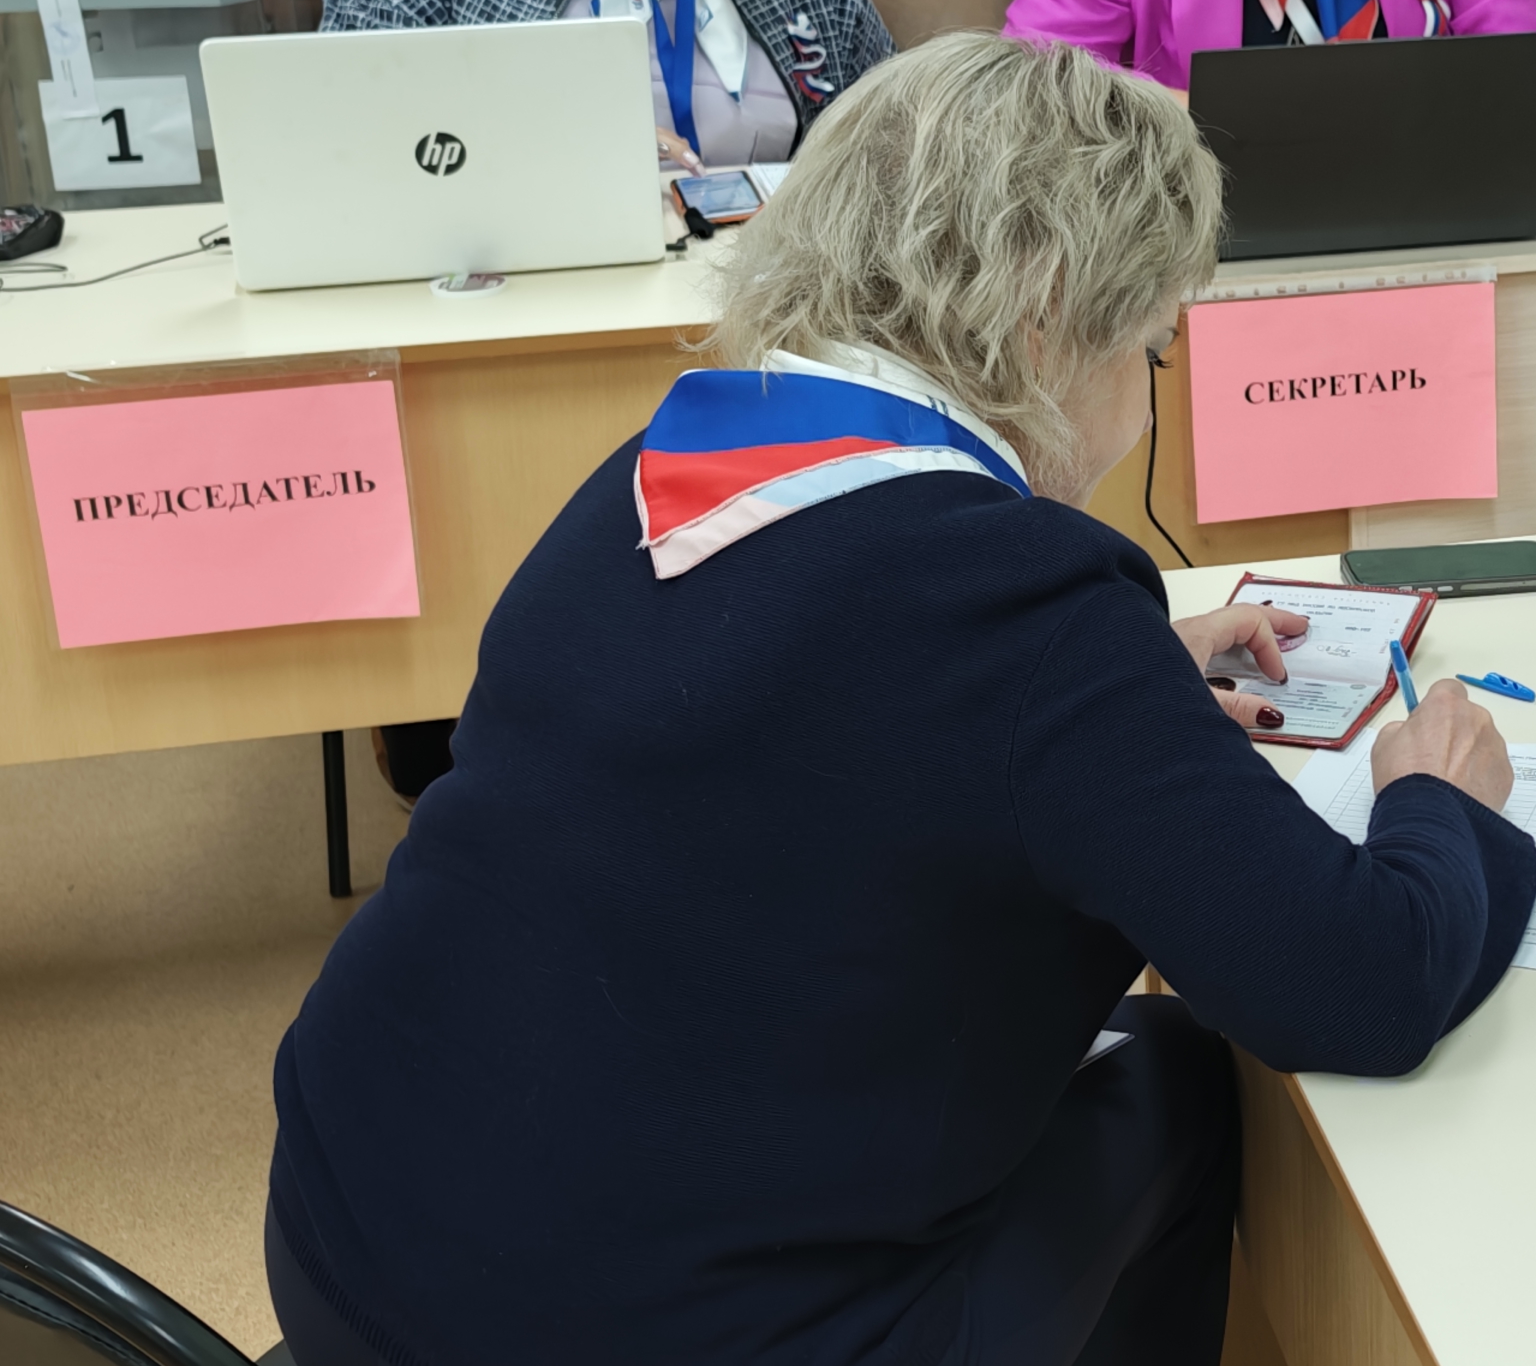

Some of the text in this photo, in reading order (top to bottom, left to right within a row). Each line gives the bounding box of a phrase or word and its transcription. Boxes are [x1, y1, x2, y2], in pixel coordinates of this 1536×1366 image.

[101, 108, 144, 164] 1
[420, 132, 462, 176] hp
[1244, 368, 1427, 405] СЕКРЕТАРЬ
[73, 469, 377, 523] ПРЕДСЕДАТЕЛЬ
